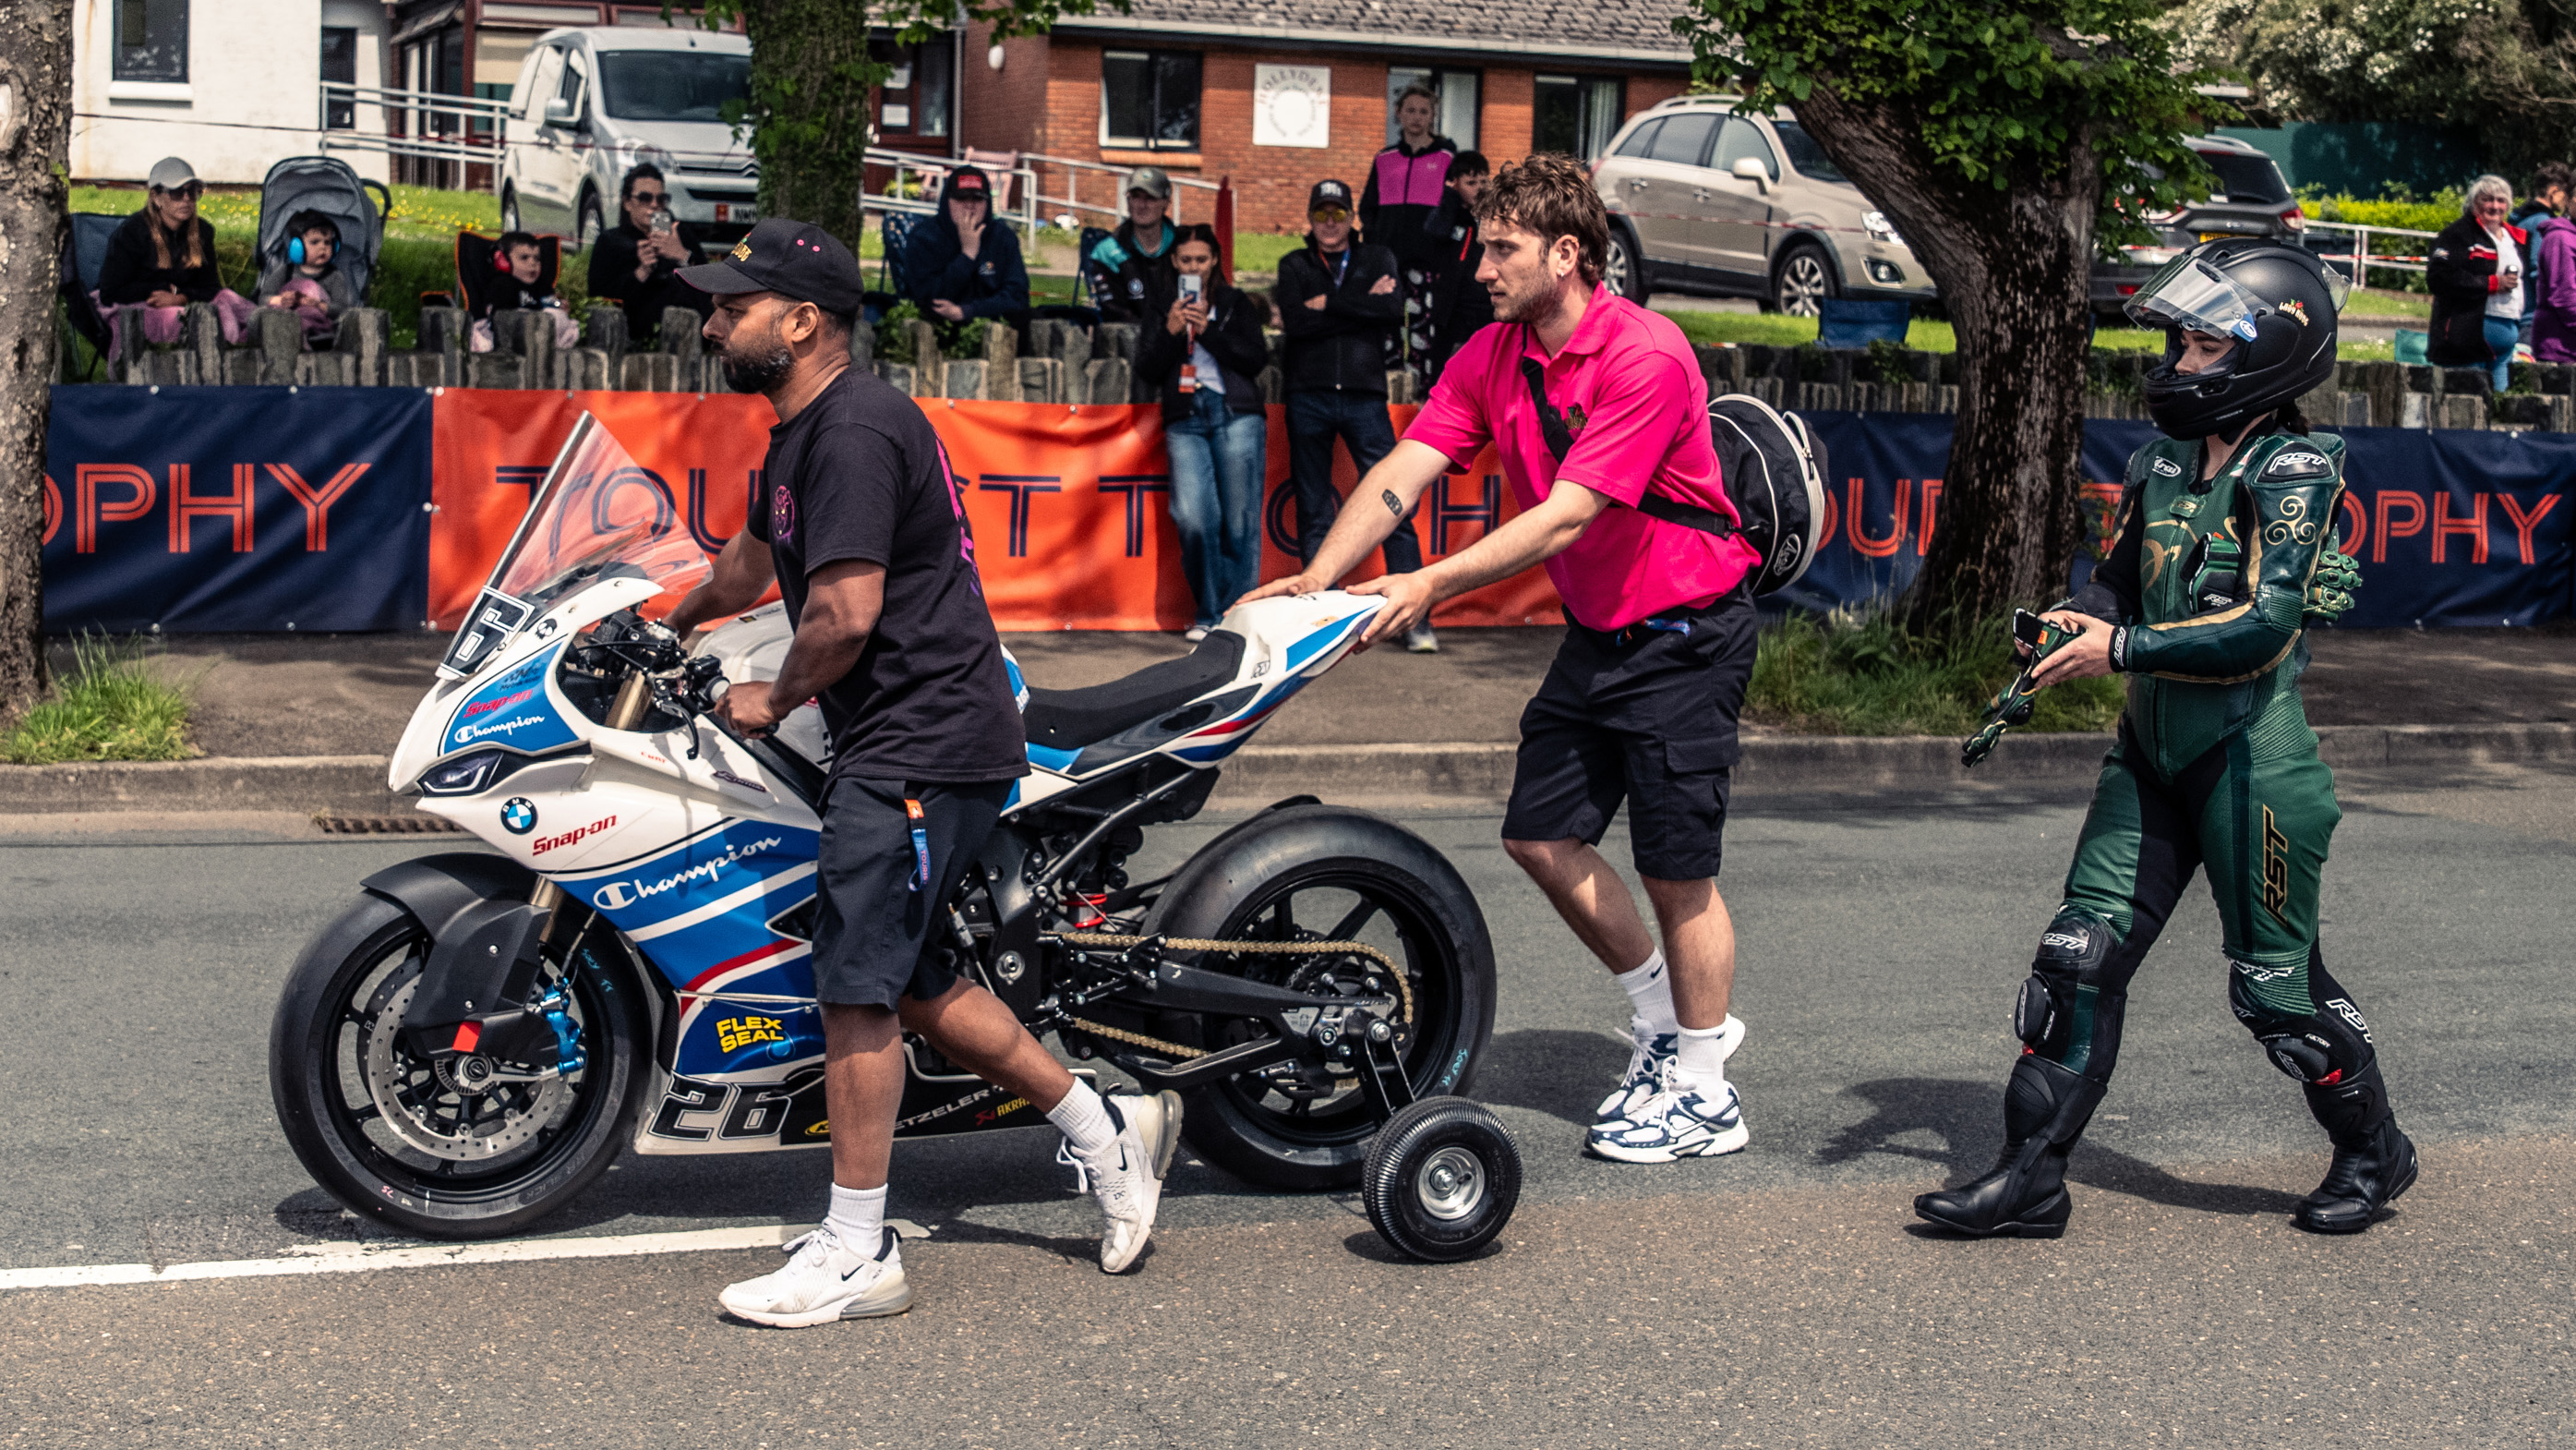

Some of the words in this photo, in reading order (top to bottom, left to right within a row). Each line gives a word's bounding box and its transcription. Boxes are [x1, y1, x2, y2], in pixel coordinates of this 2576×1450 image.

[2268, 453, 2328, 474] RST
[463, 689, 533, 719] Snap-on
[454, 716, 545, 743] Champion
[532, 815, 617, 856] Snap-on
[594, 837, 782, 910] Champion
[2262, 804, 2288, 926] RST
[2041, 933, 2088, 949] RST
[716, 1017, 783, 1038] FLEX
[719, 1030, 784, 1054] SEAL
[647, 1070, 792, 1142] 26
[894, 1088, 990, 1130] ETZELER
[997, 1097, 1030, 1118] AKRA
